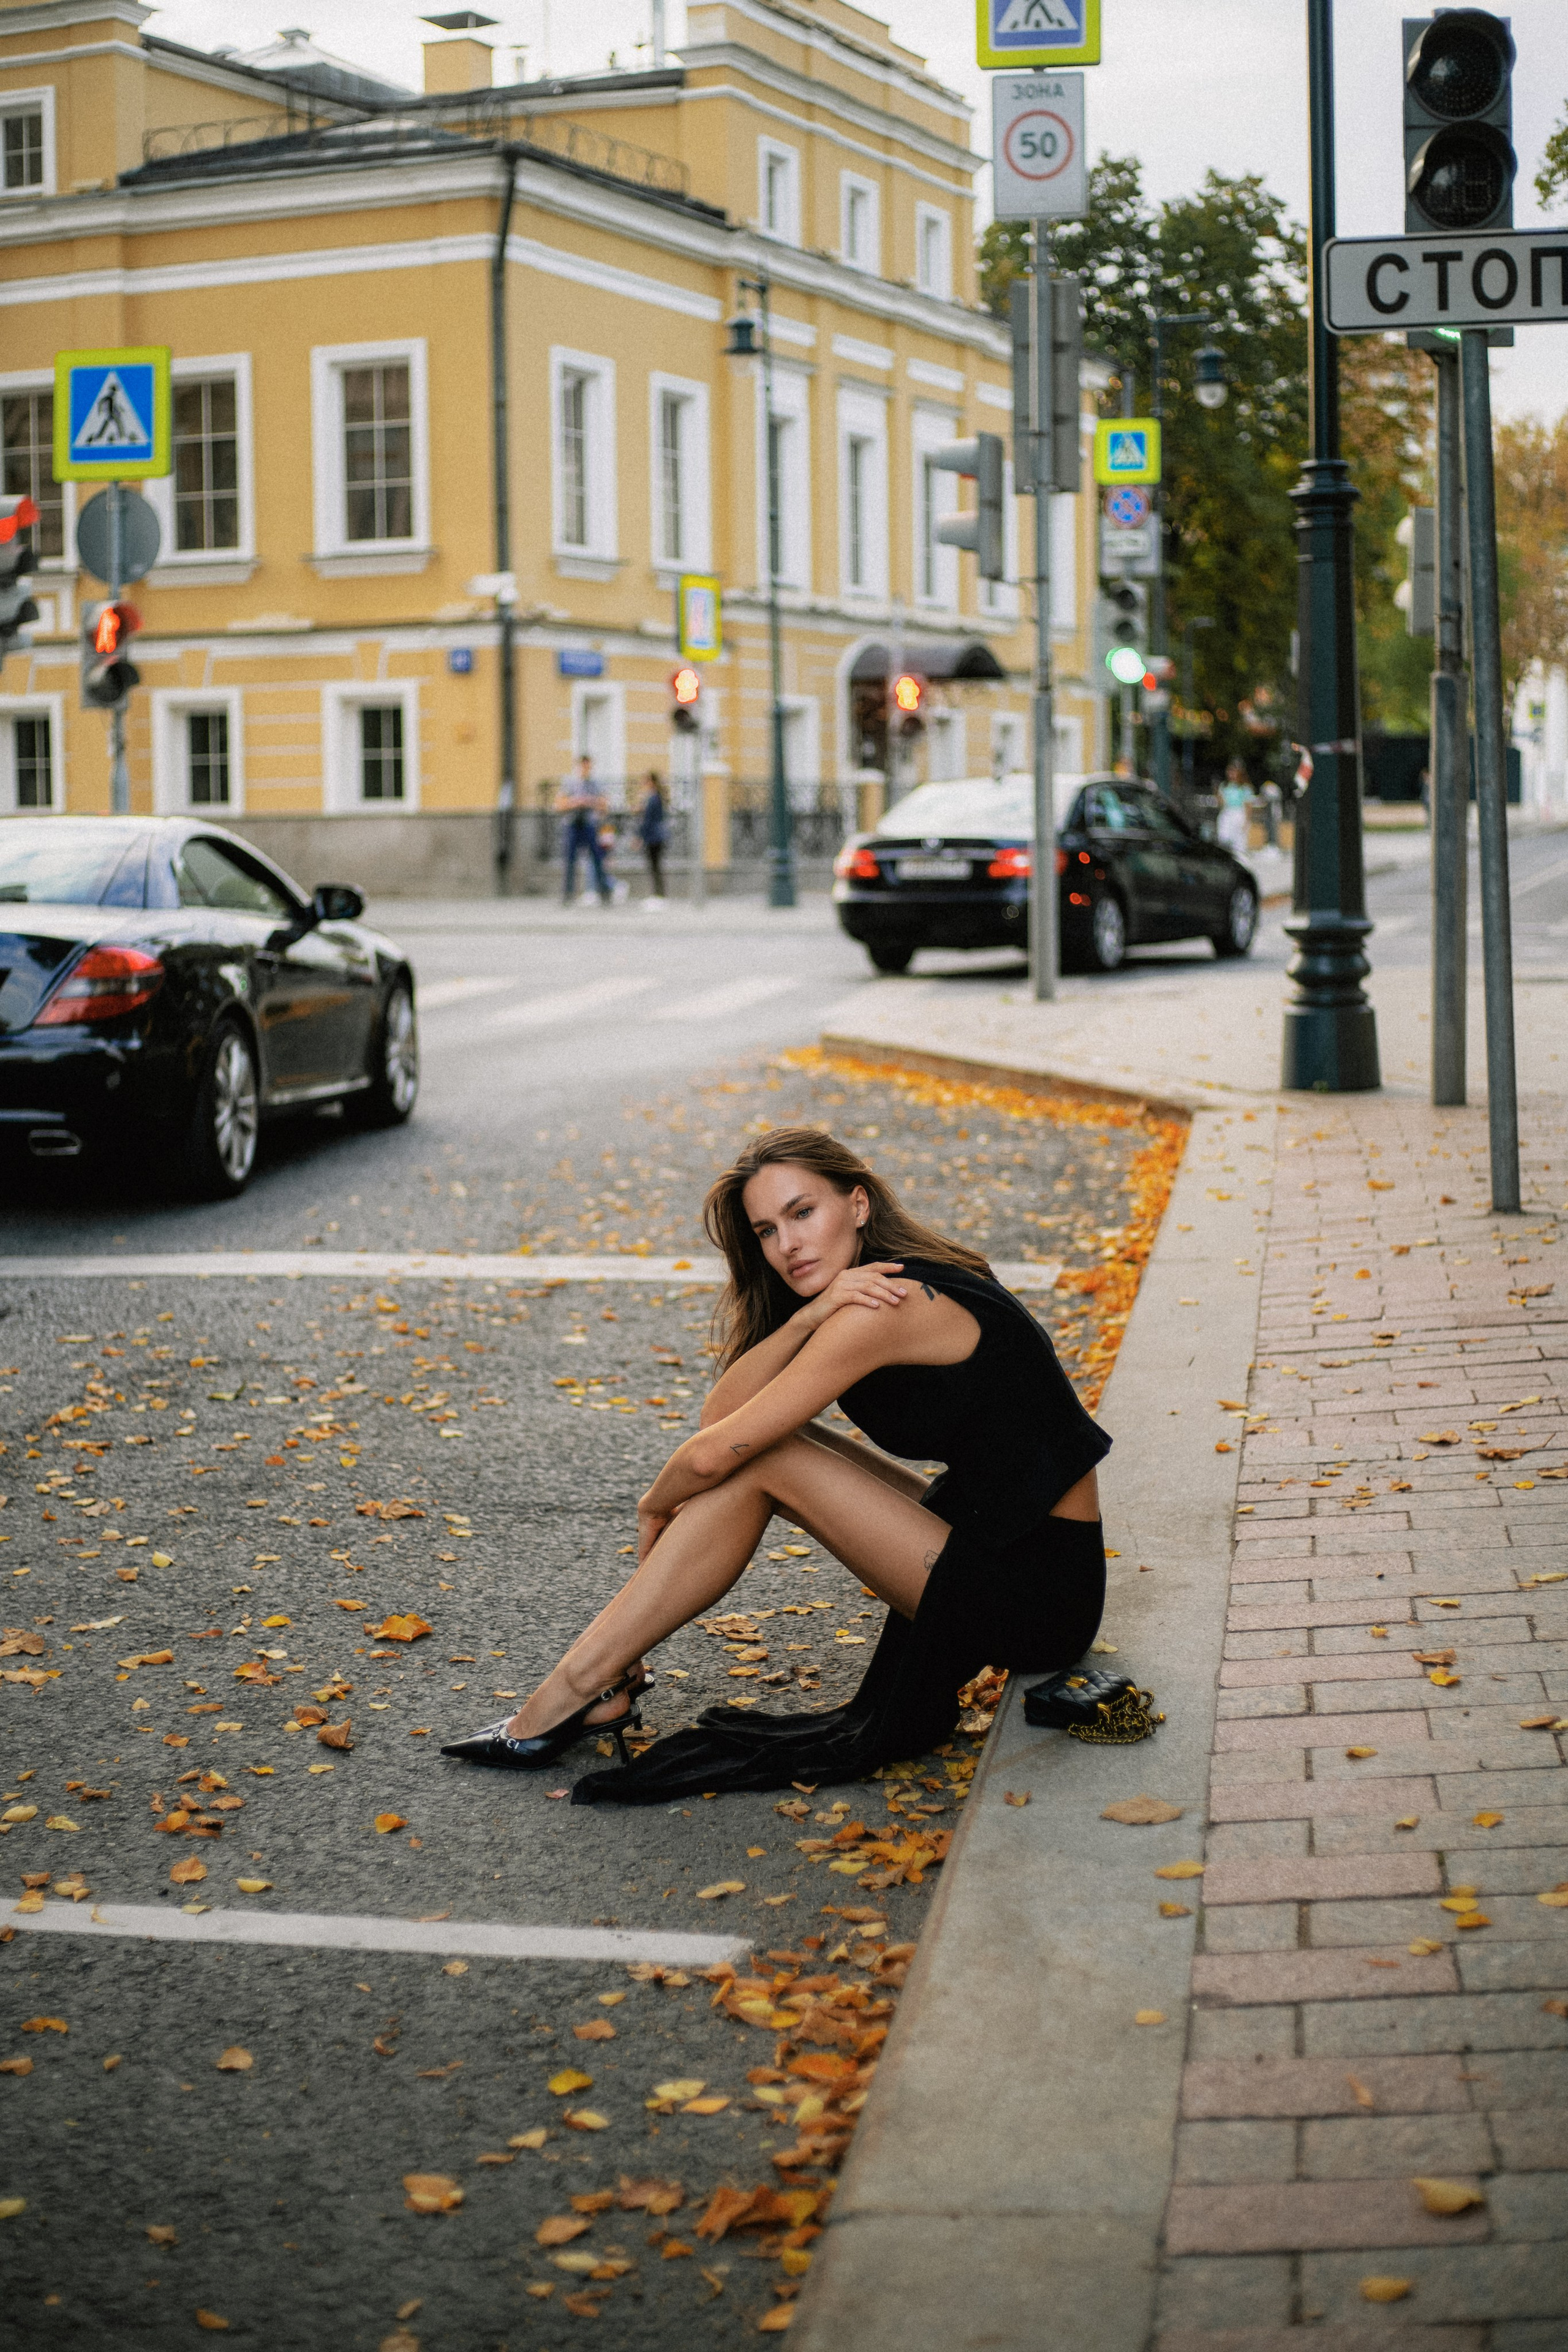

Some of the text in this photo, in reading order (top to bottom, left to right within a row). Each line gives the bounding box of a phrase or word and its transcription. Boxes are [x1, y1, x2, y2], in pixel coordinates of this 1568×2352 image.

[1012, 83, 1065, 99] ЗОНА
[1020, 131, 1057, 159] 50
[1366, 246, 1568, 315] СТОП
